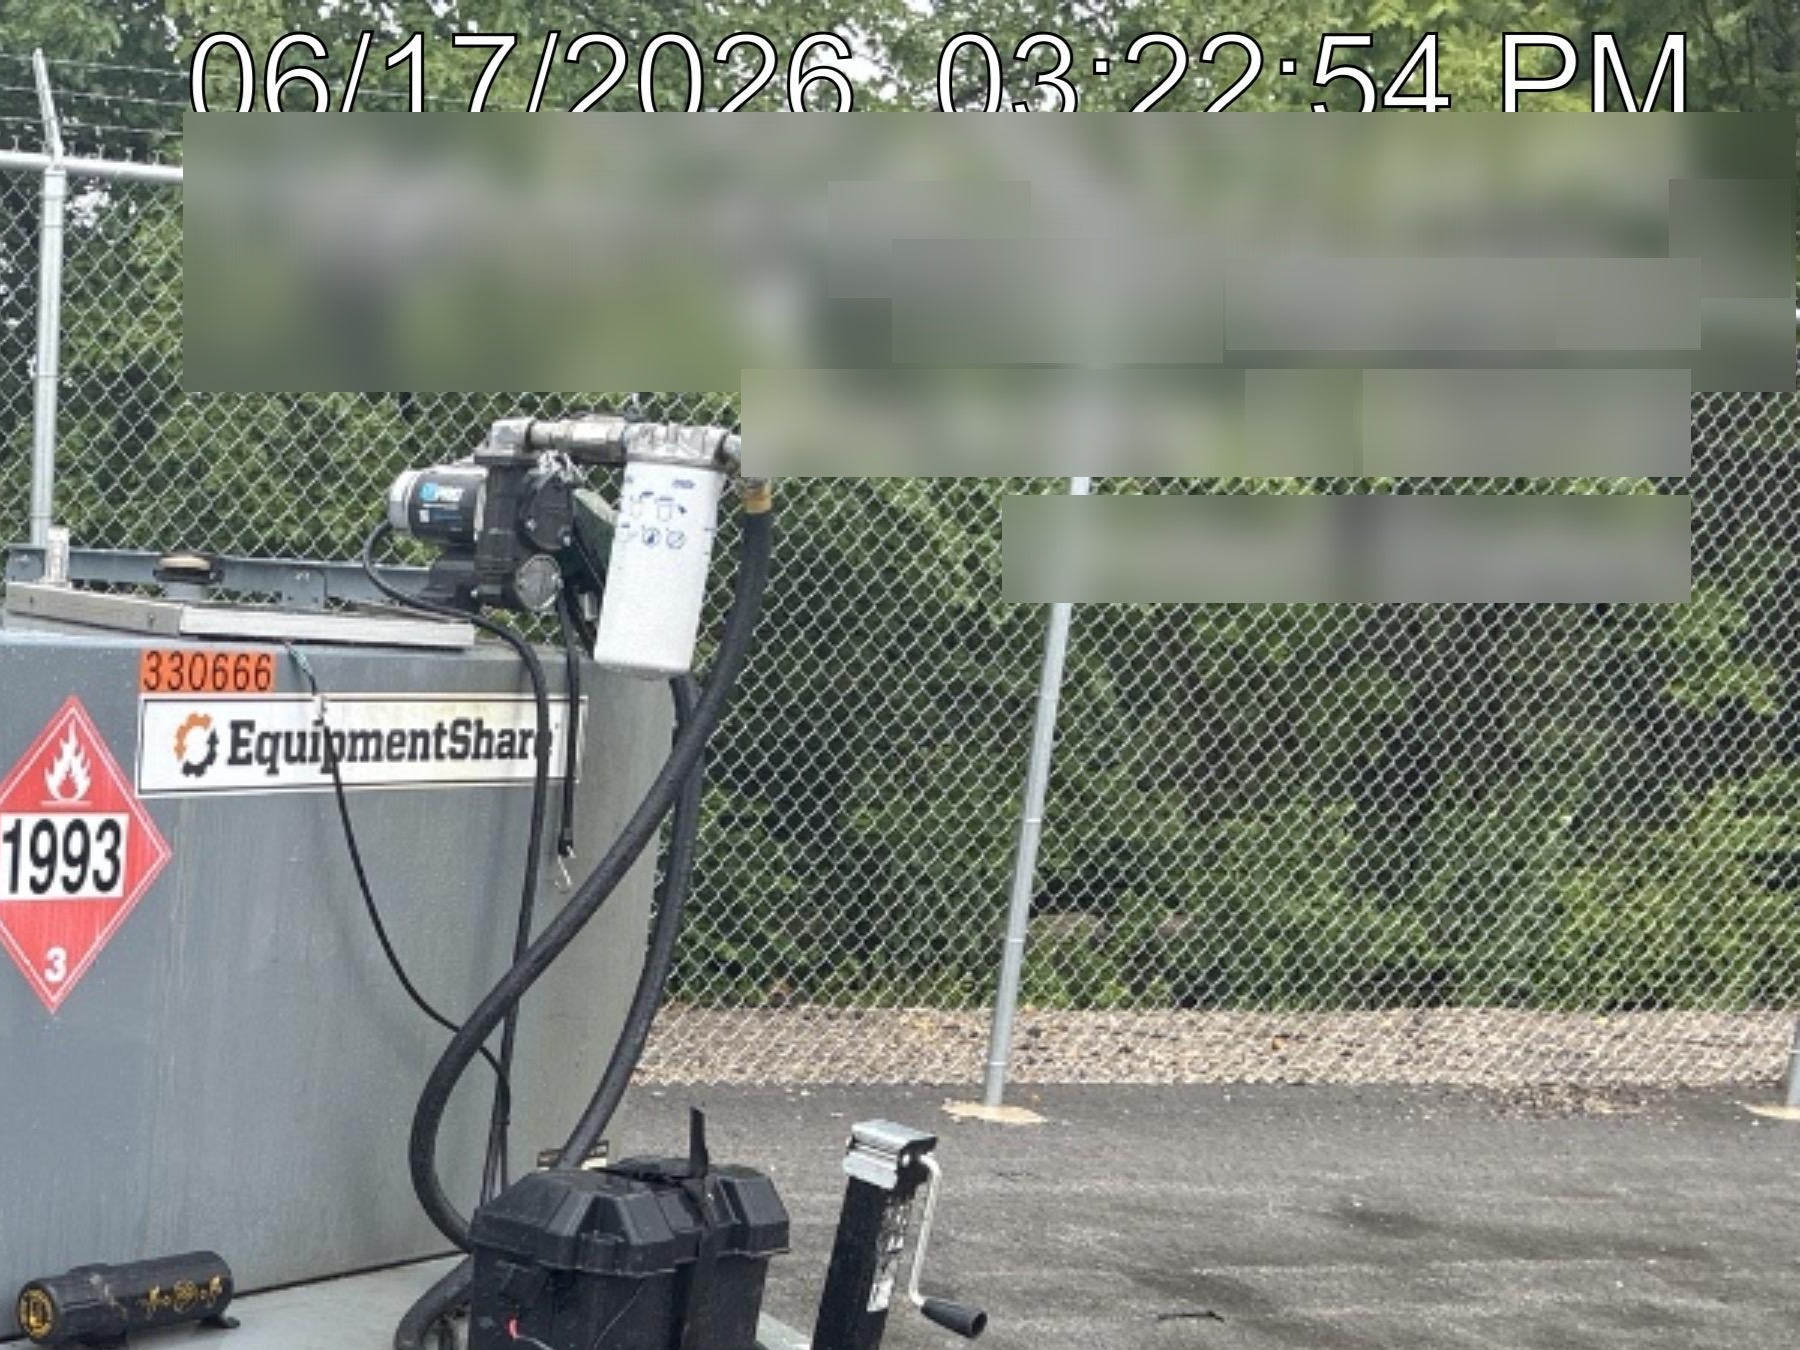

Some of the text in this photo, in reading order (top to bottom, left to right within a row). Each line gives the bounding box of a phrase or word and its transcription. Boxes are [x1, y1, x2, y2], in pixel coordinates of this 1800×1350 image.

[142, 650, 273, 691] 330666
[1, 818, 122, 894] 1993
[45, 946, 67, 983] 3
